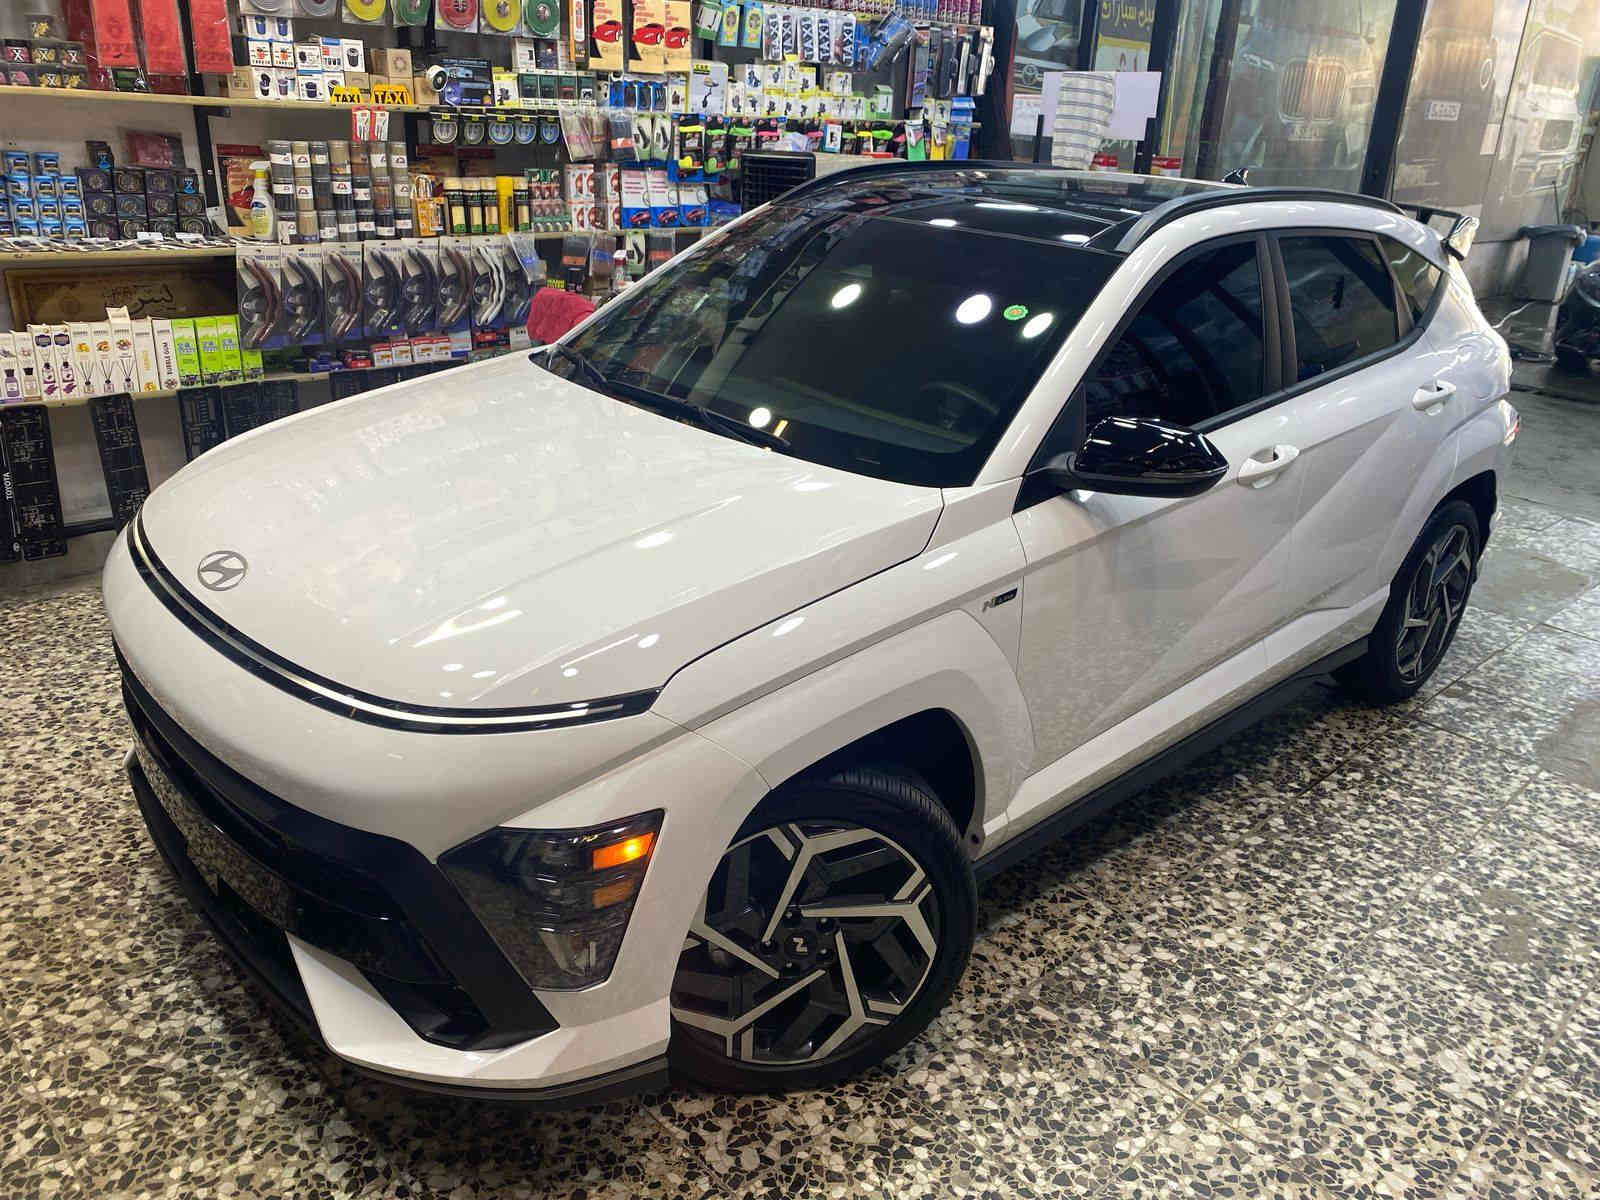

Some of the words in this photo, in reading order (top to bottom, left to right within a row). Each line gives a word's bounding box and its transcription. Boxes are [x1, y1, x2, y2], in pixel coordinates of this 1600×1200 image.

[770, 19, 780, 57] TAXI
[802, 21, 813, 58] TAXI
[818, 23, 830, 58] TAXI
[843, 25, 854, 62] TAXI
[334, 94, 361, 103] TAXI
[374, 91, 409, 104] TAXI
[3, 472, 14, 500] TOYOTA
